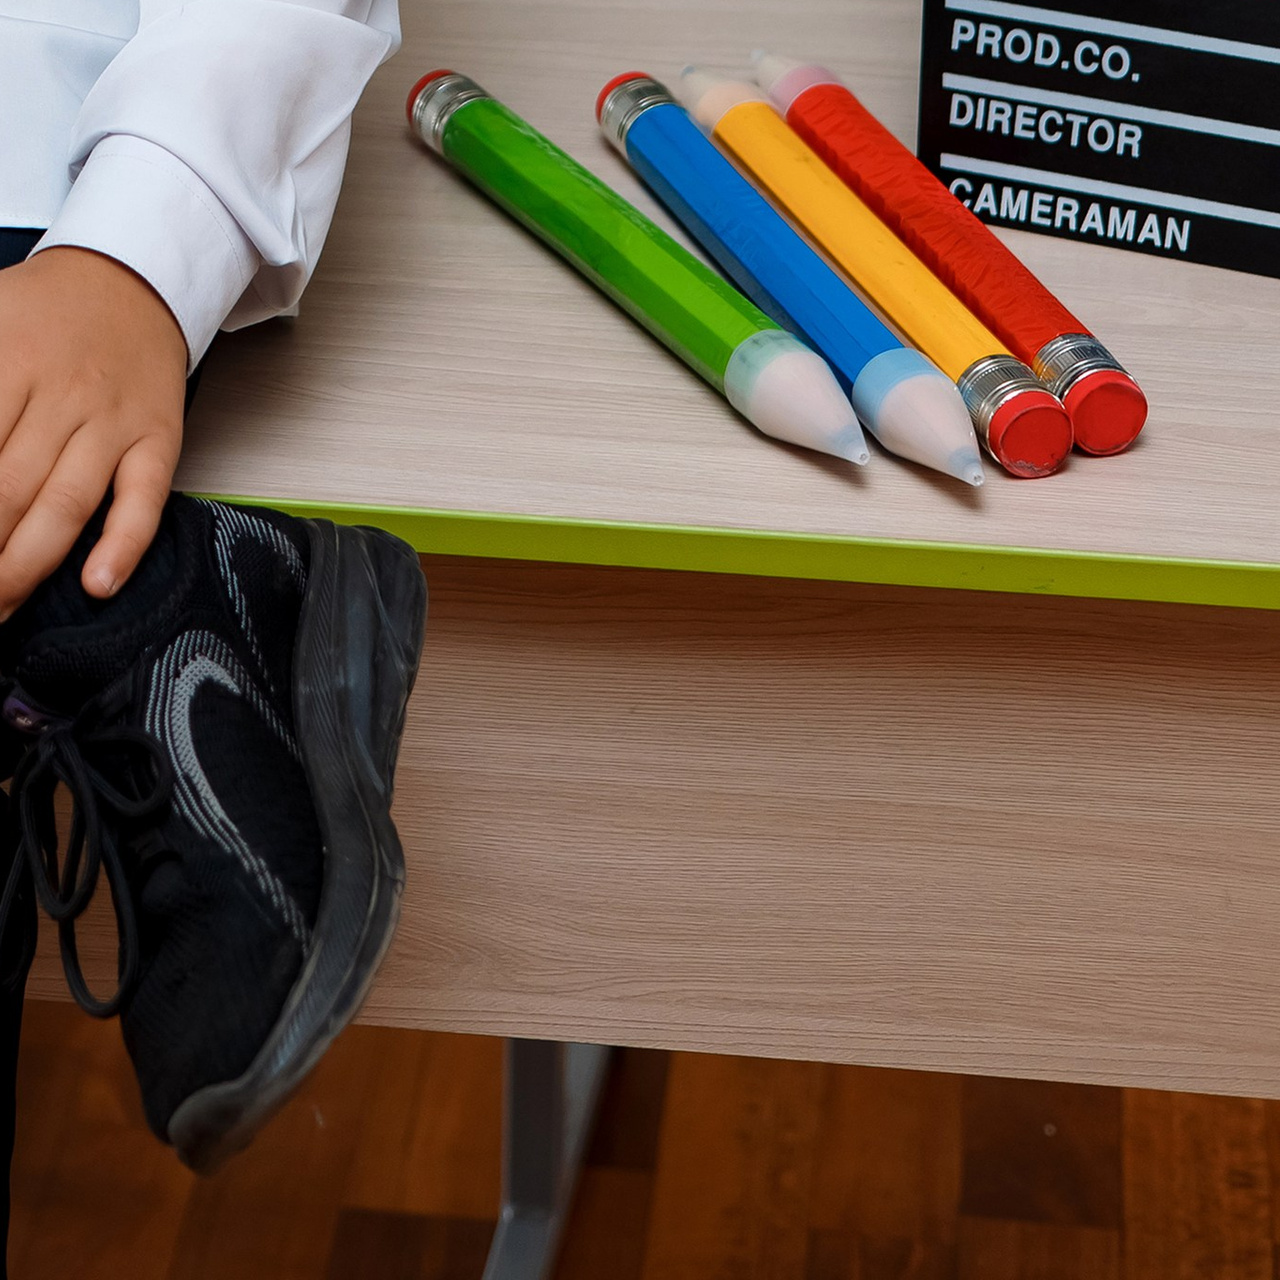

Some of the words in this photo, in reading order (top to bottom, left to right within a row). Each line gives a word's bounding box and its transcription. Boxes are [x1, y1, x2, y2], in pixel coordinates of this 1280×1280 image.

[950, 18, 1140, 82] PROD.CO.
[949, 93, 1143, 158] DIRECTOR
[948, 178, 1191, 252] CAMERAMAN
